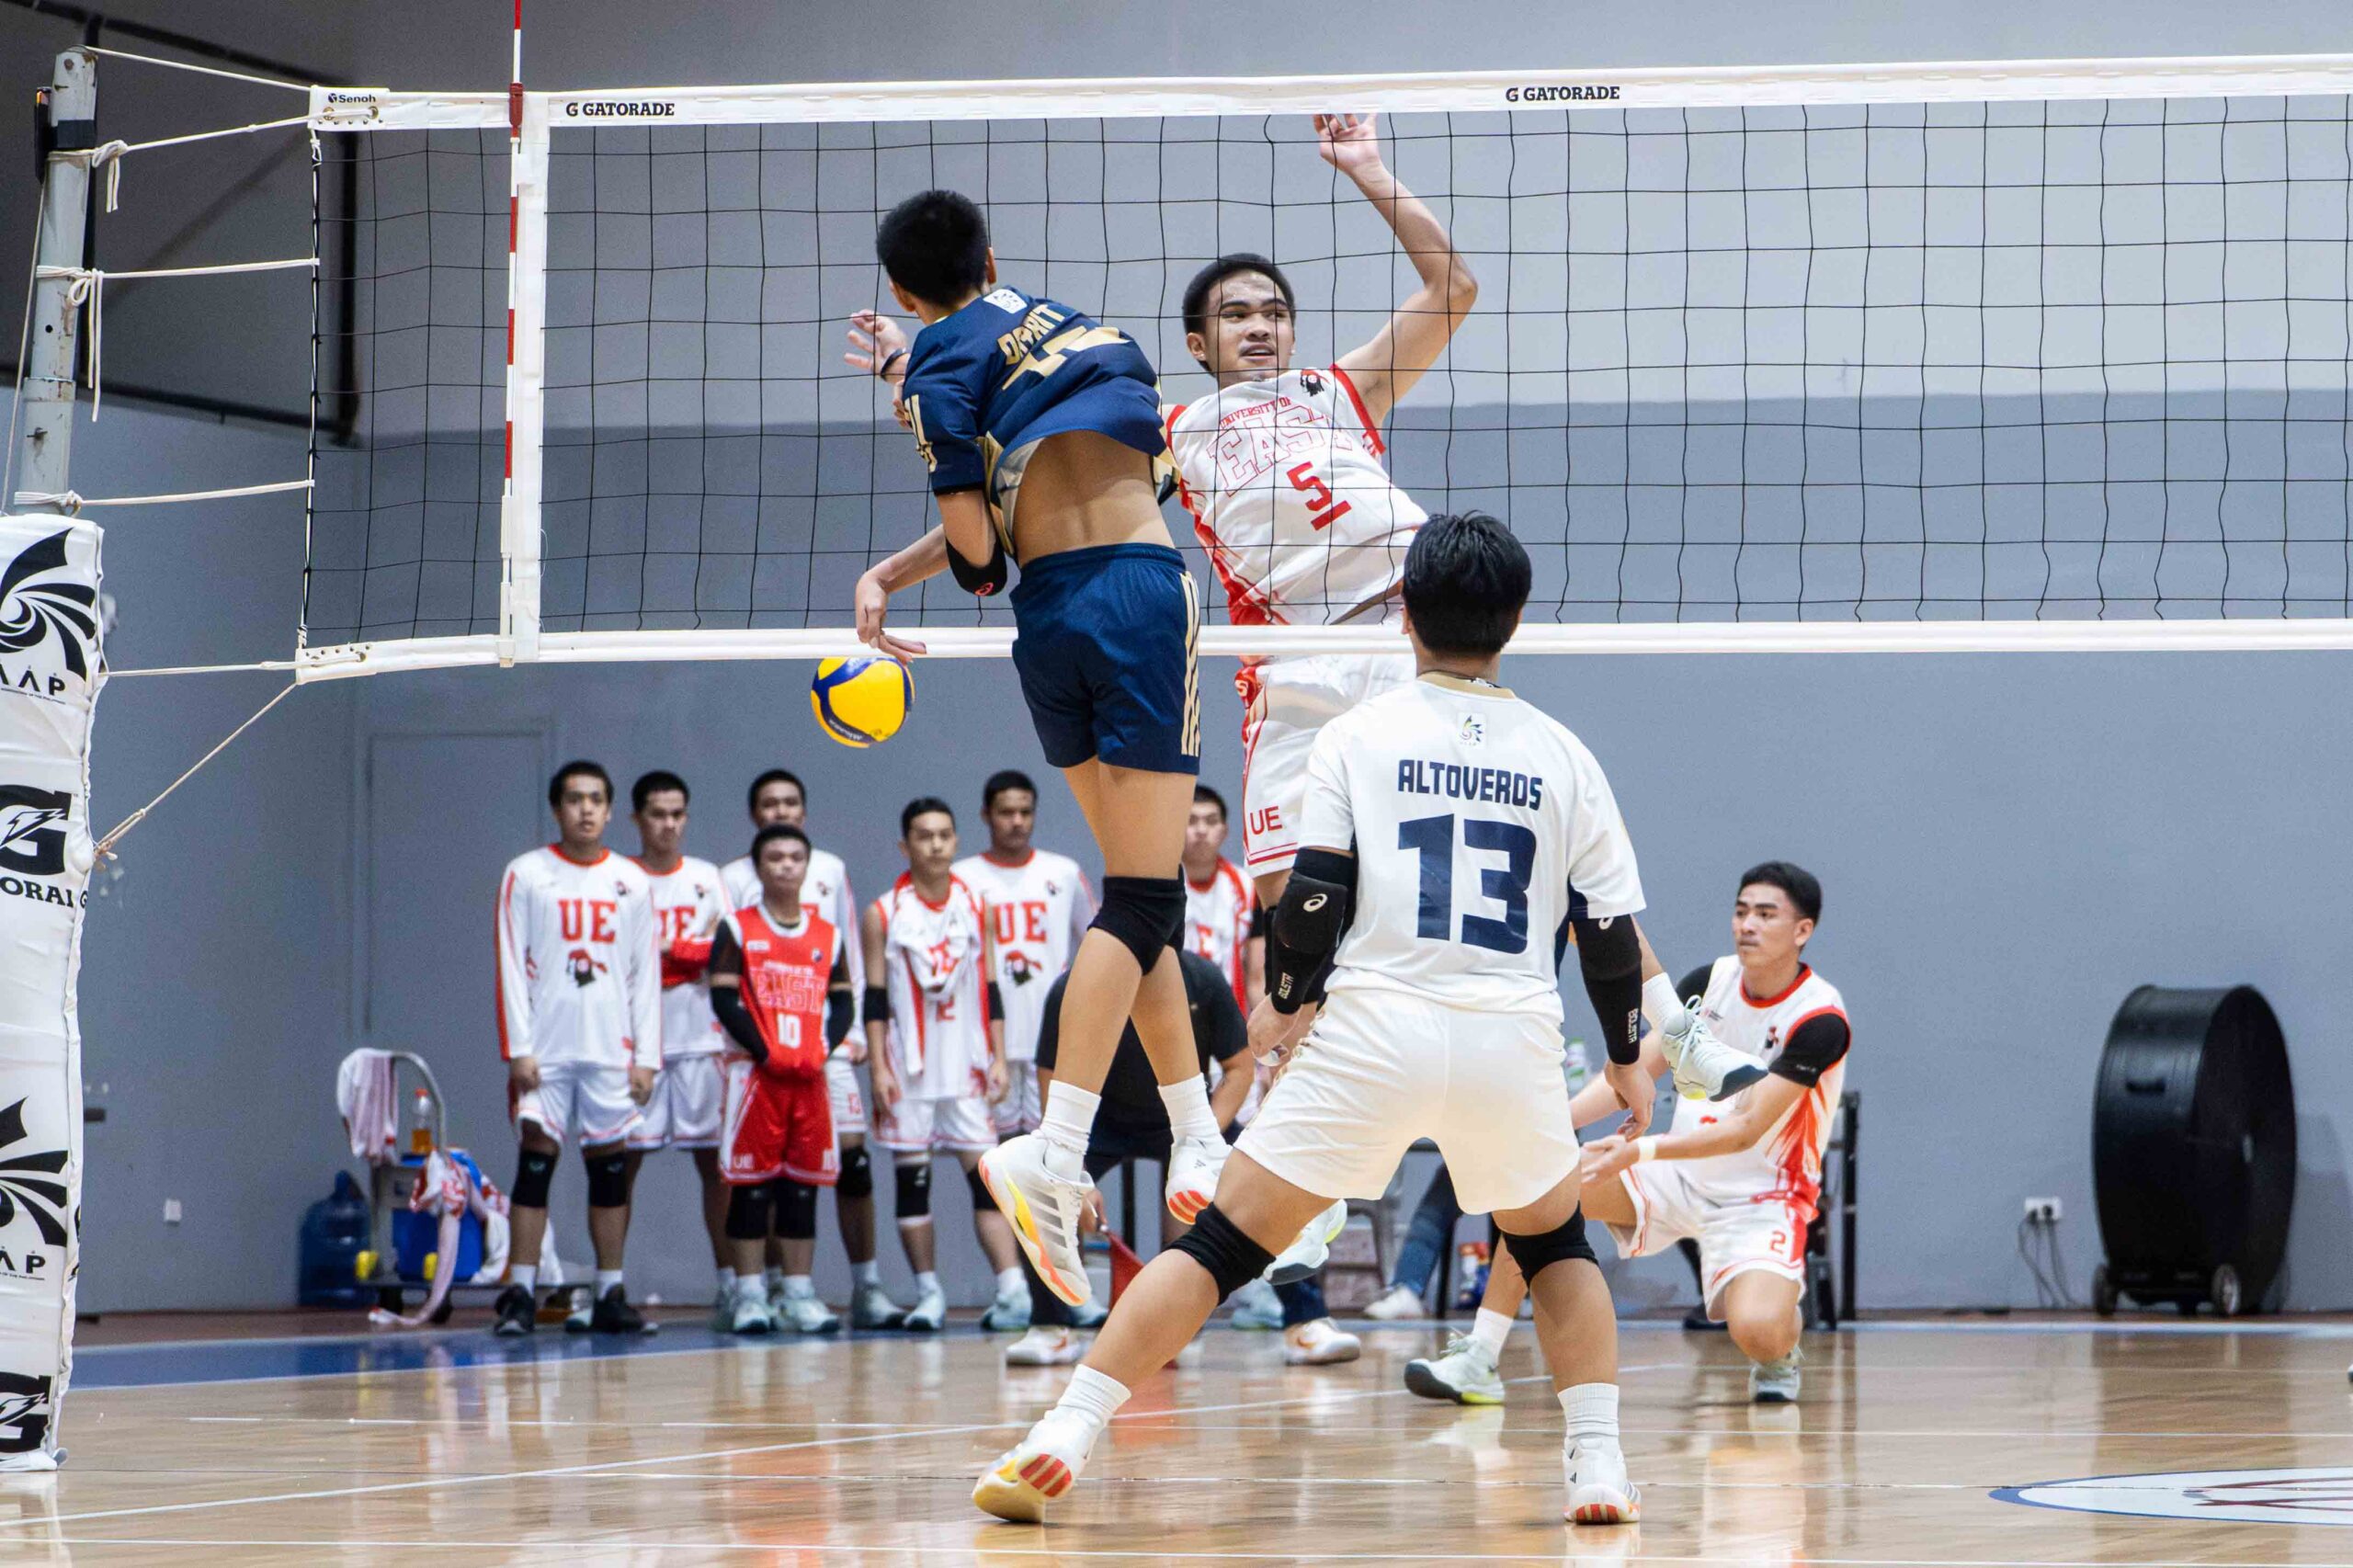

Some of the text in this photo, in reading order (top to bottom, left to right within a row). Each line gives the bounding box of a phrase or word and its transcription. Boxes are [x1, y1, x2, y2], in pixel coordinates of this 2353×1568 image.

[338, 94, 376, 103] Senoh
[1523, 85, 1620, 101] GATORADE
[583, 102, 675, 116] GATORADE
[1219, 399, 1277, 429] UNIVERSITY
[1398, 759, 1542, 811] ALTOVEROS
[1250, 805, 1283, 835] UE
[1398, 813, 1537, 955] 13
[557, 898, 618, 944] UE
[993, 902, 1047, 945] UE
[777, 1013, 801, 1050] 10
[1770, 1230, 1787, 1255] 2
